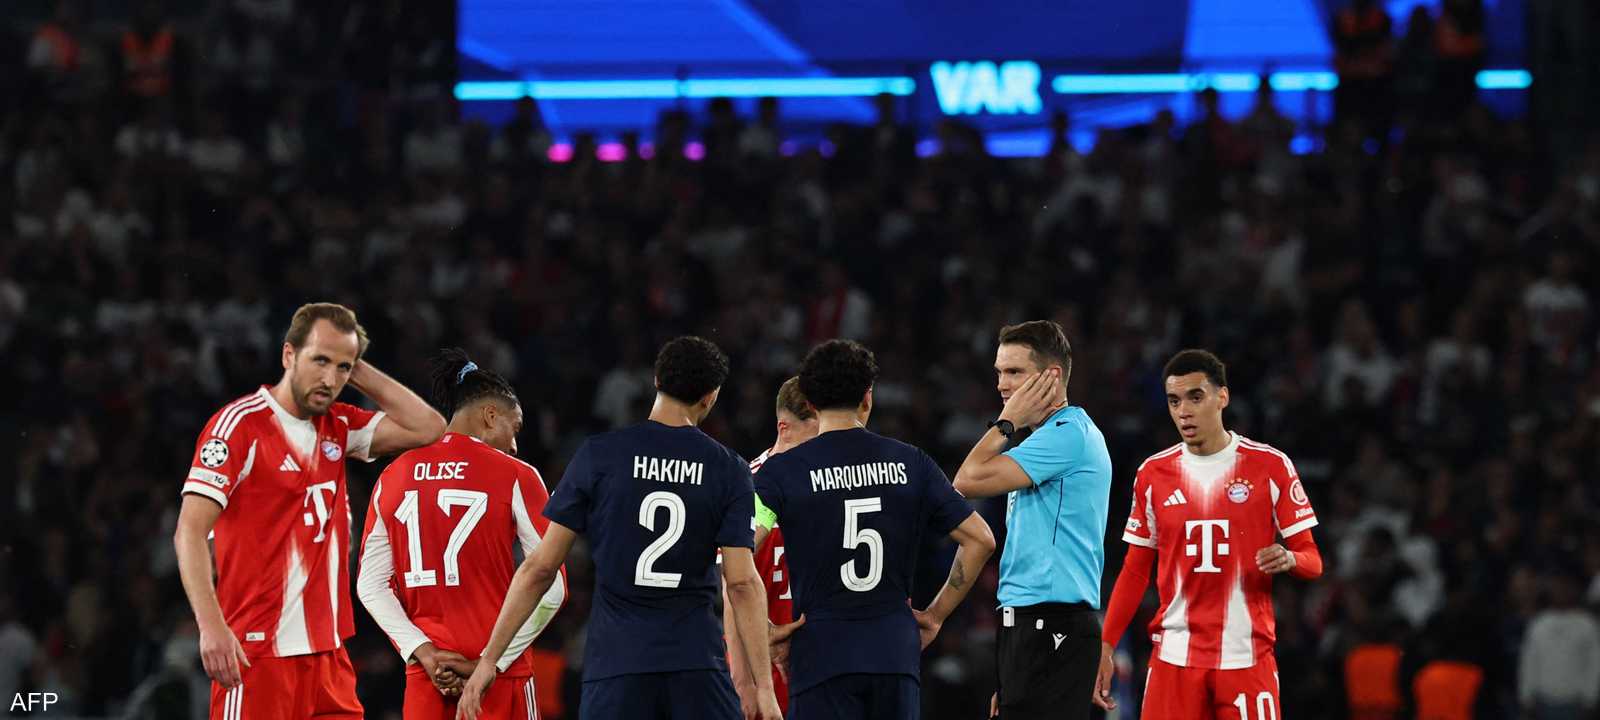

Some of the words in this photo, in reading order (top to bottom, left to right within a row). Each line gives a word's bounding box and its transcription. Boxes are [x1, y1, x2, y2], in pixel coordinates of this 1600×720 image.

[930, 61, 1042, 115] VAR
[414, 462, 468, 480] OLISE
[633, 456, 703, 485] HAKIMI
[810, 462, 907, 492] MARQUINHOS
[394, 489, 488, 588] 17
[634, 491, 686, 588] 2
[840, 497, 884, 592] 5
[1185, 519, 1229, 573] T
[1233, 691, 1276, 720] 10
